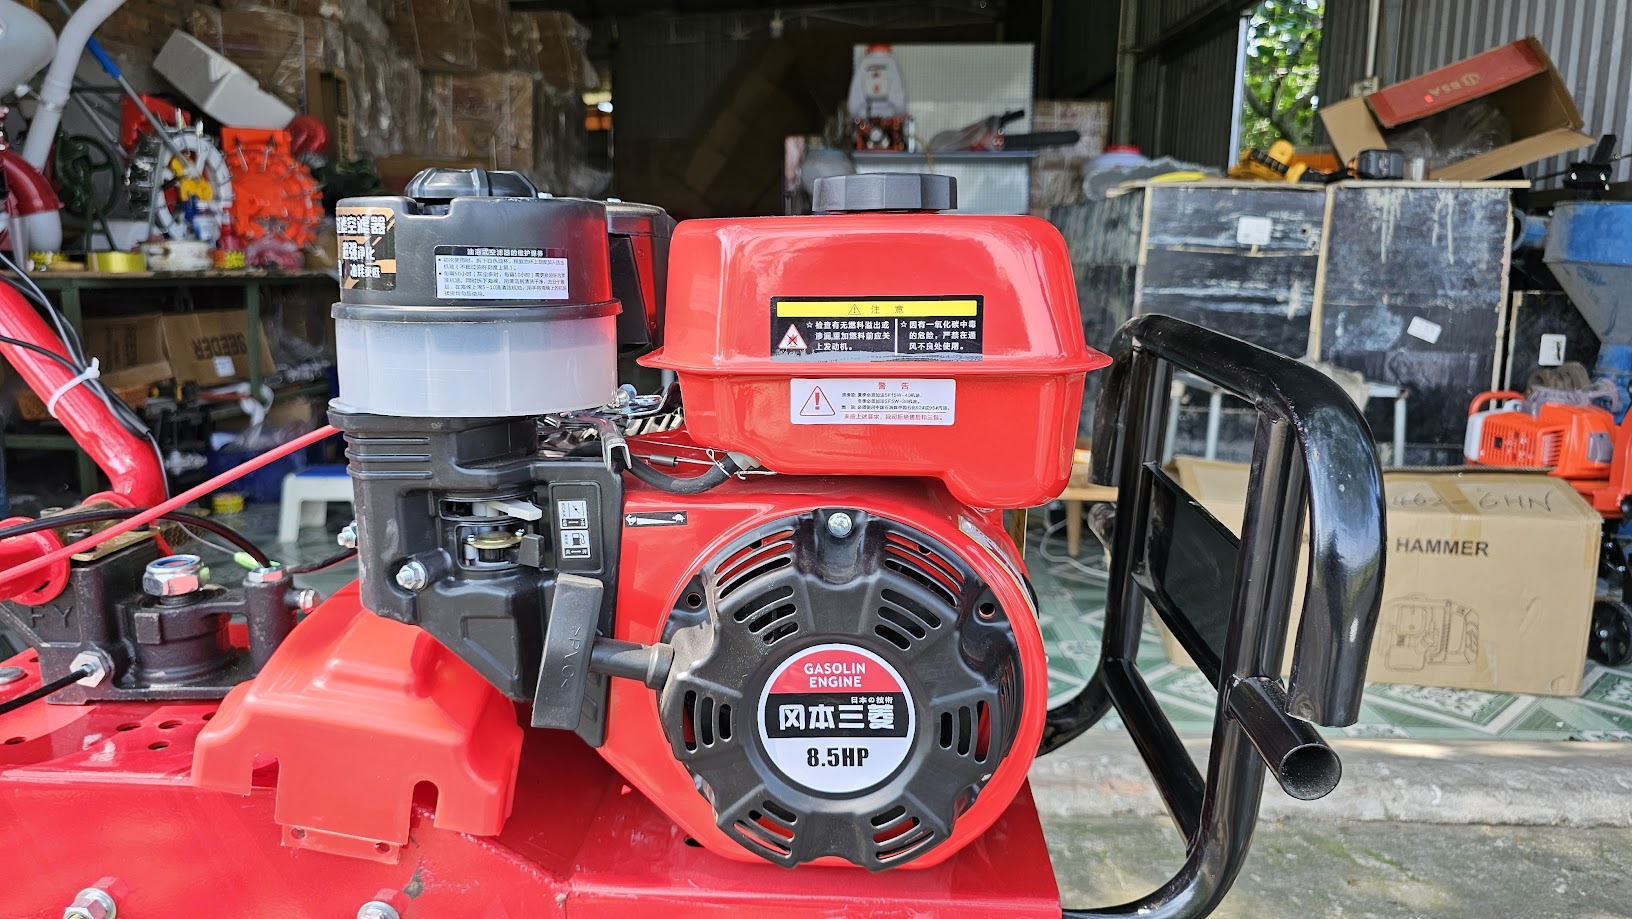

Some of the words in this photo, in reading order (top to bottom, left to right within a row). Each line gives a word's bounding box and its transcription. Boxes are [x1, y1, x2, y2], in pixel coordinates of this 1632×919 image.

[1395, 538, 1490, 558] HAMMER
[804, 662, 866, 675] GASOLIN
[809, 676, 862, 688] ENGINE
[851, 696, 894, 704] 日本の技術
[779, 704, 894, 730] 冈本三菱
[806, 747, 869, 767] 8.5HP
